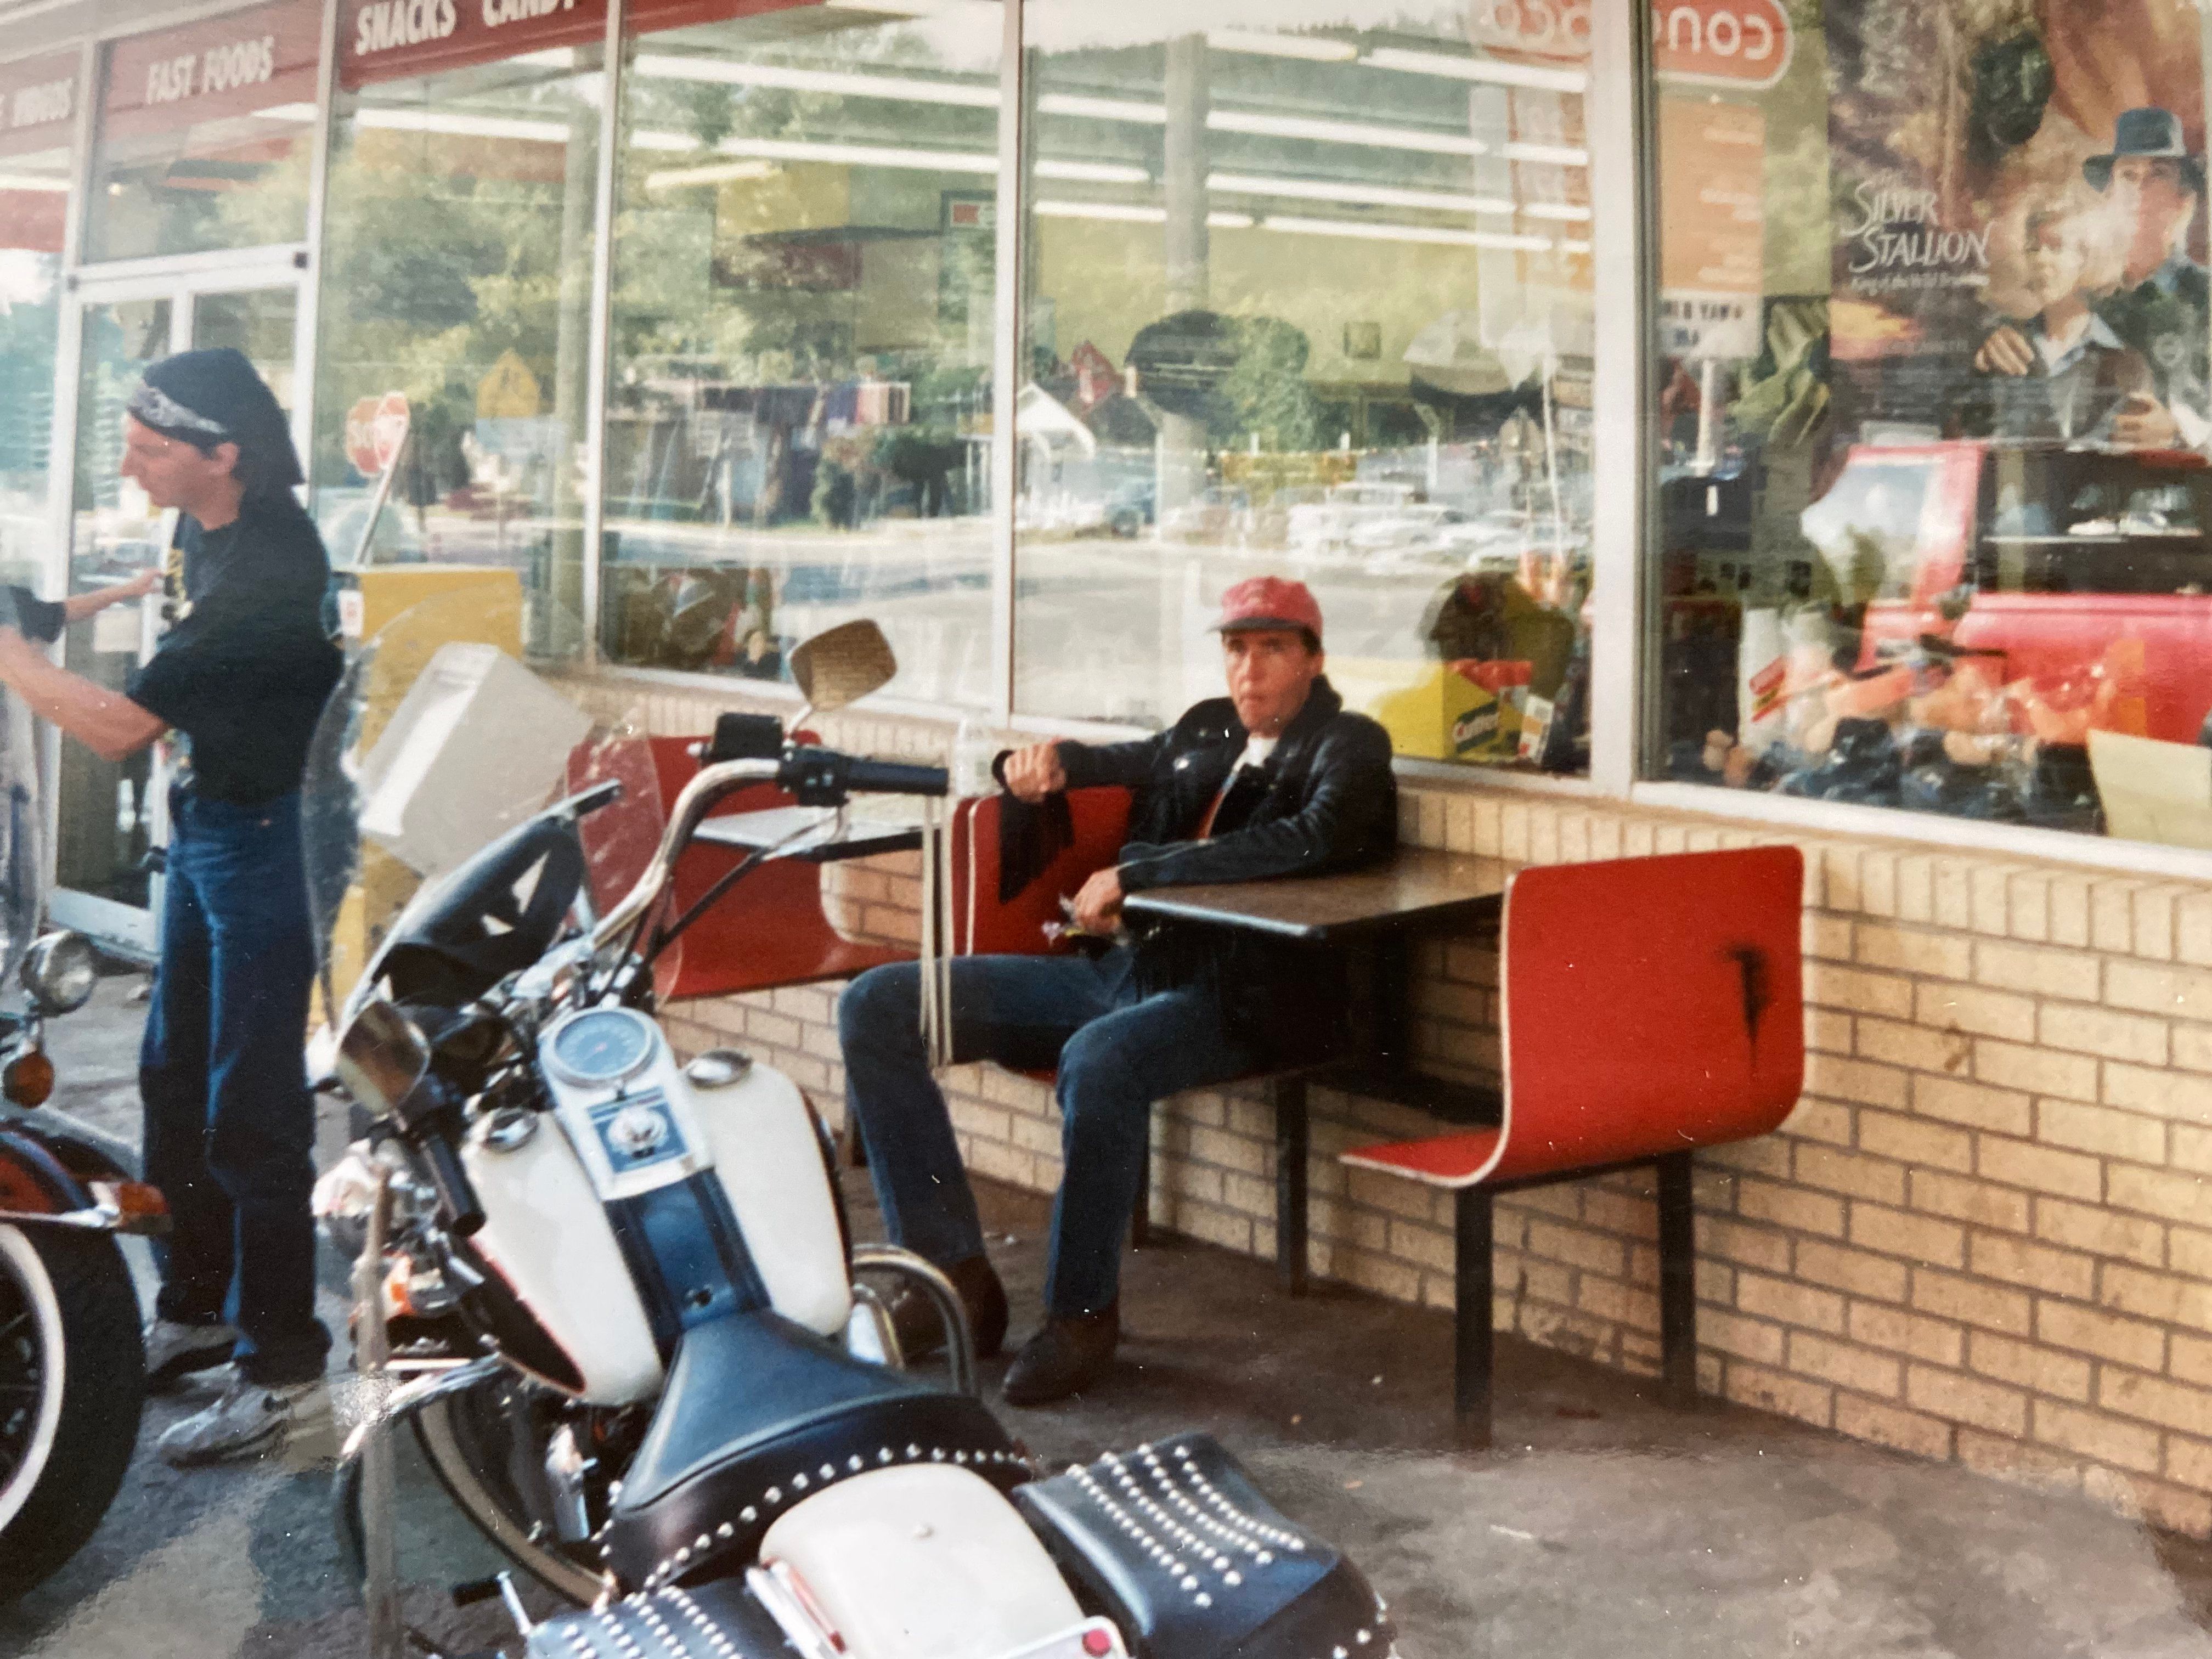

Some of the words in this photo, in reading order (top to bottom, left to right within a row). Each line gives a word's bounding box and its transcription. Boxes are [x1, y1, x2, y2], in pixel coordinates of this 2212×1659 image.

[354, 0, 457, 56] SNACKS
[145, 53, 196, 104] FAST
[201, 36, 274, 93] FOODS
[1848, 221, 1997, 273] STALLION
